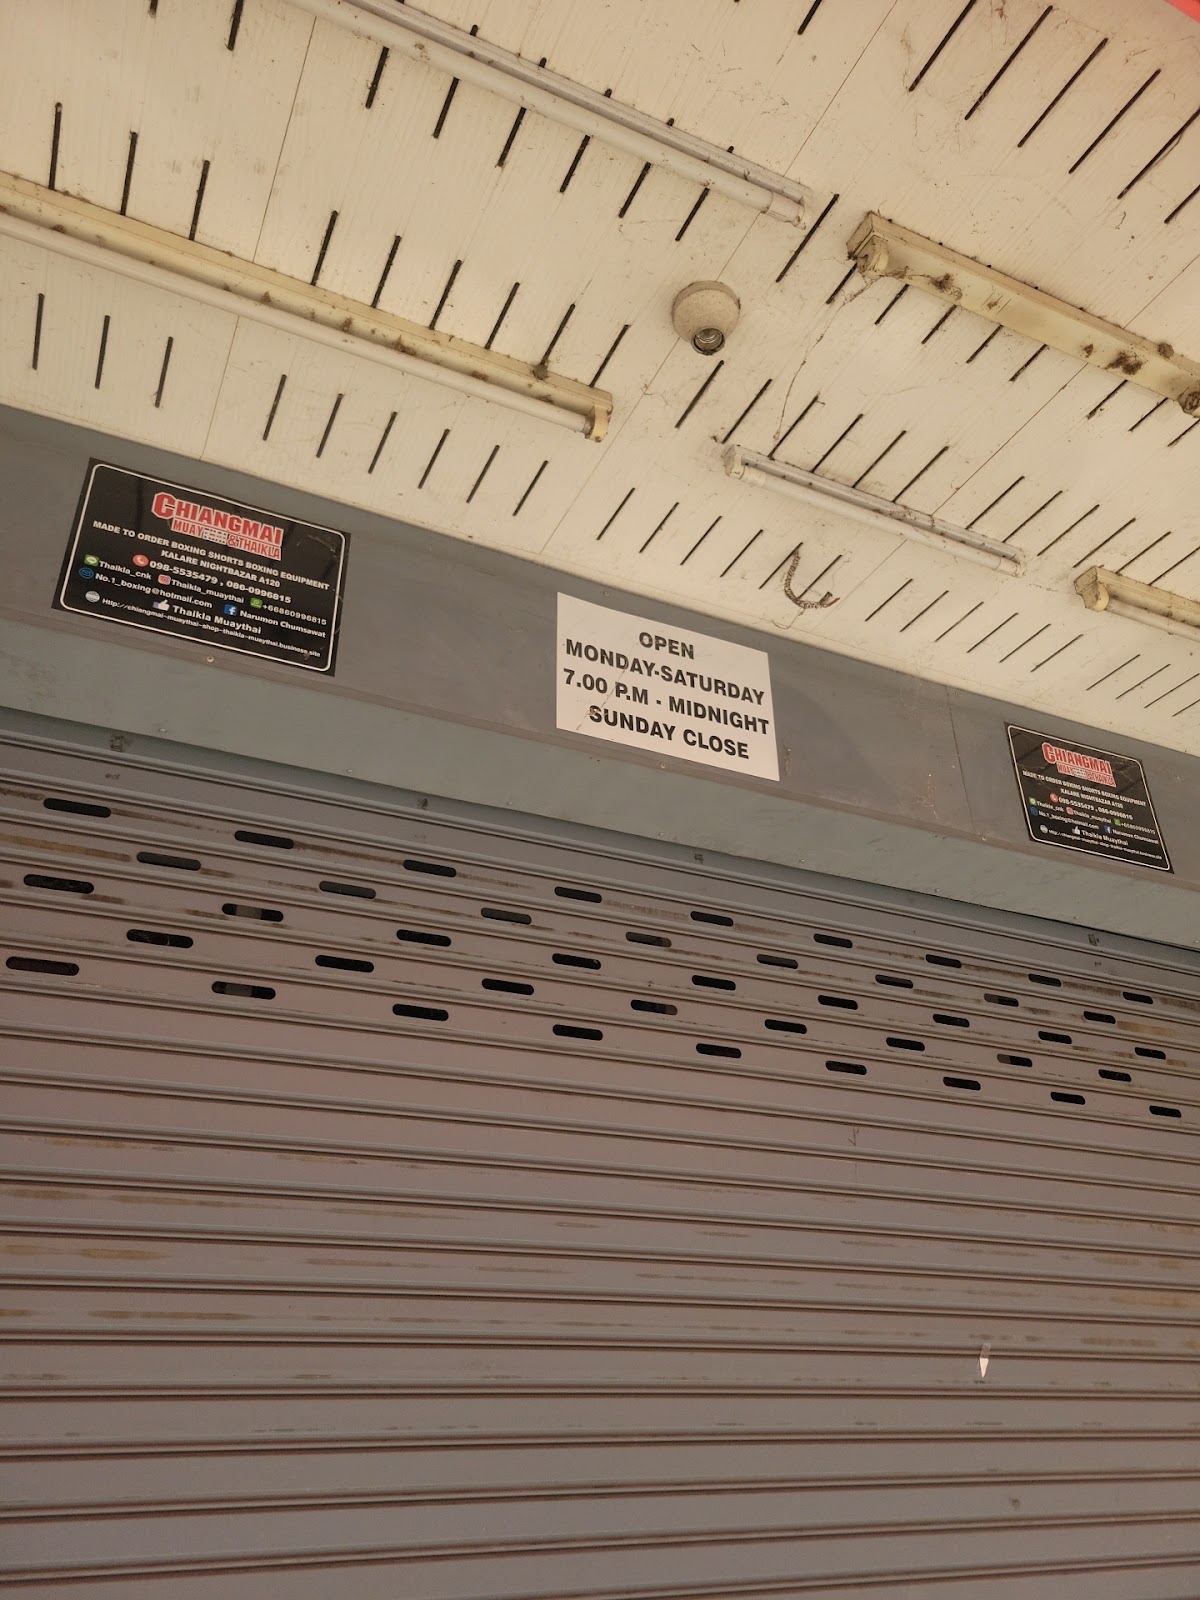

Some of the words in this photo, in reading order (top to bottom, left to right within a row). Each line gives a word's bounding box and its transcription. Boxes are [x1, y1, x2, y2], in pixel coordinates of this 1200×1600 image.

[152, 492, 283, 546] CHIANGMAI
[171, 520, 204, 538] MUAY
[92, 520, 120, 534] MADE
[123, 528, 136, 538] TO
[137, 532, 169, 547] ORDER
[171, 541, 206, 556] BOXING
[208, 552, 244, 567] SHORTS
[245, 561, 279, 577] BOXING
[280, 571, 330, 590] EQUIPMENT
[99, 560, 152, 580] Thaikla_cnk
[161, 550, 198, 565] KALARE
[200, 560, 258, 581] NIGHTBAZAR
[258, 577, 280, 588] A120
[149, 560, 218, 584] 098-5535479
[226, 580, 292, 604] 086-0996815
[171, 579, 244, 603] Thaikla_muaythai
[172, 605, 212, 622] Thaikla
[214, 615, 261, 634] Muaythai
[239, 610, 279, 626] Narumon
[280, 621, 326, 638] Chumsawat
[639, 632, 694, 660] OPEN
[566, 638, 765, 706] MONDAY-SATURDAY
[563, 668, 608, 694] 7.00
[615, 681, 649, 705] P.M
[669, 696, 770, 735] MIDNIGHT
[589, 705, 676, 741] SUNDAY
[683, 729, 749, 760] CLOSE
[1042, 742, 1112, 775] CHIANGMAI
